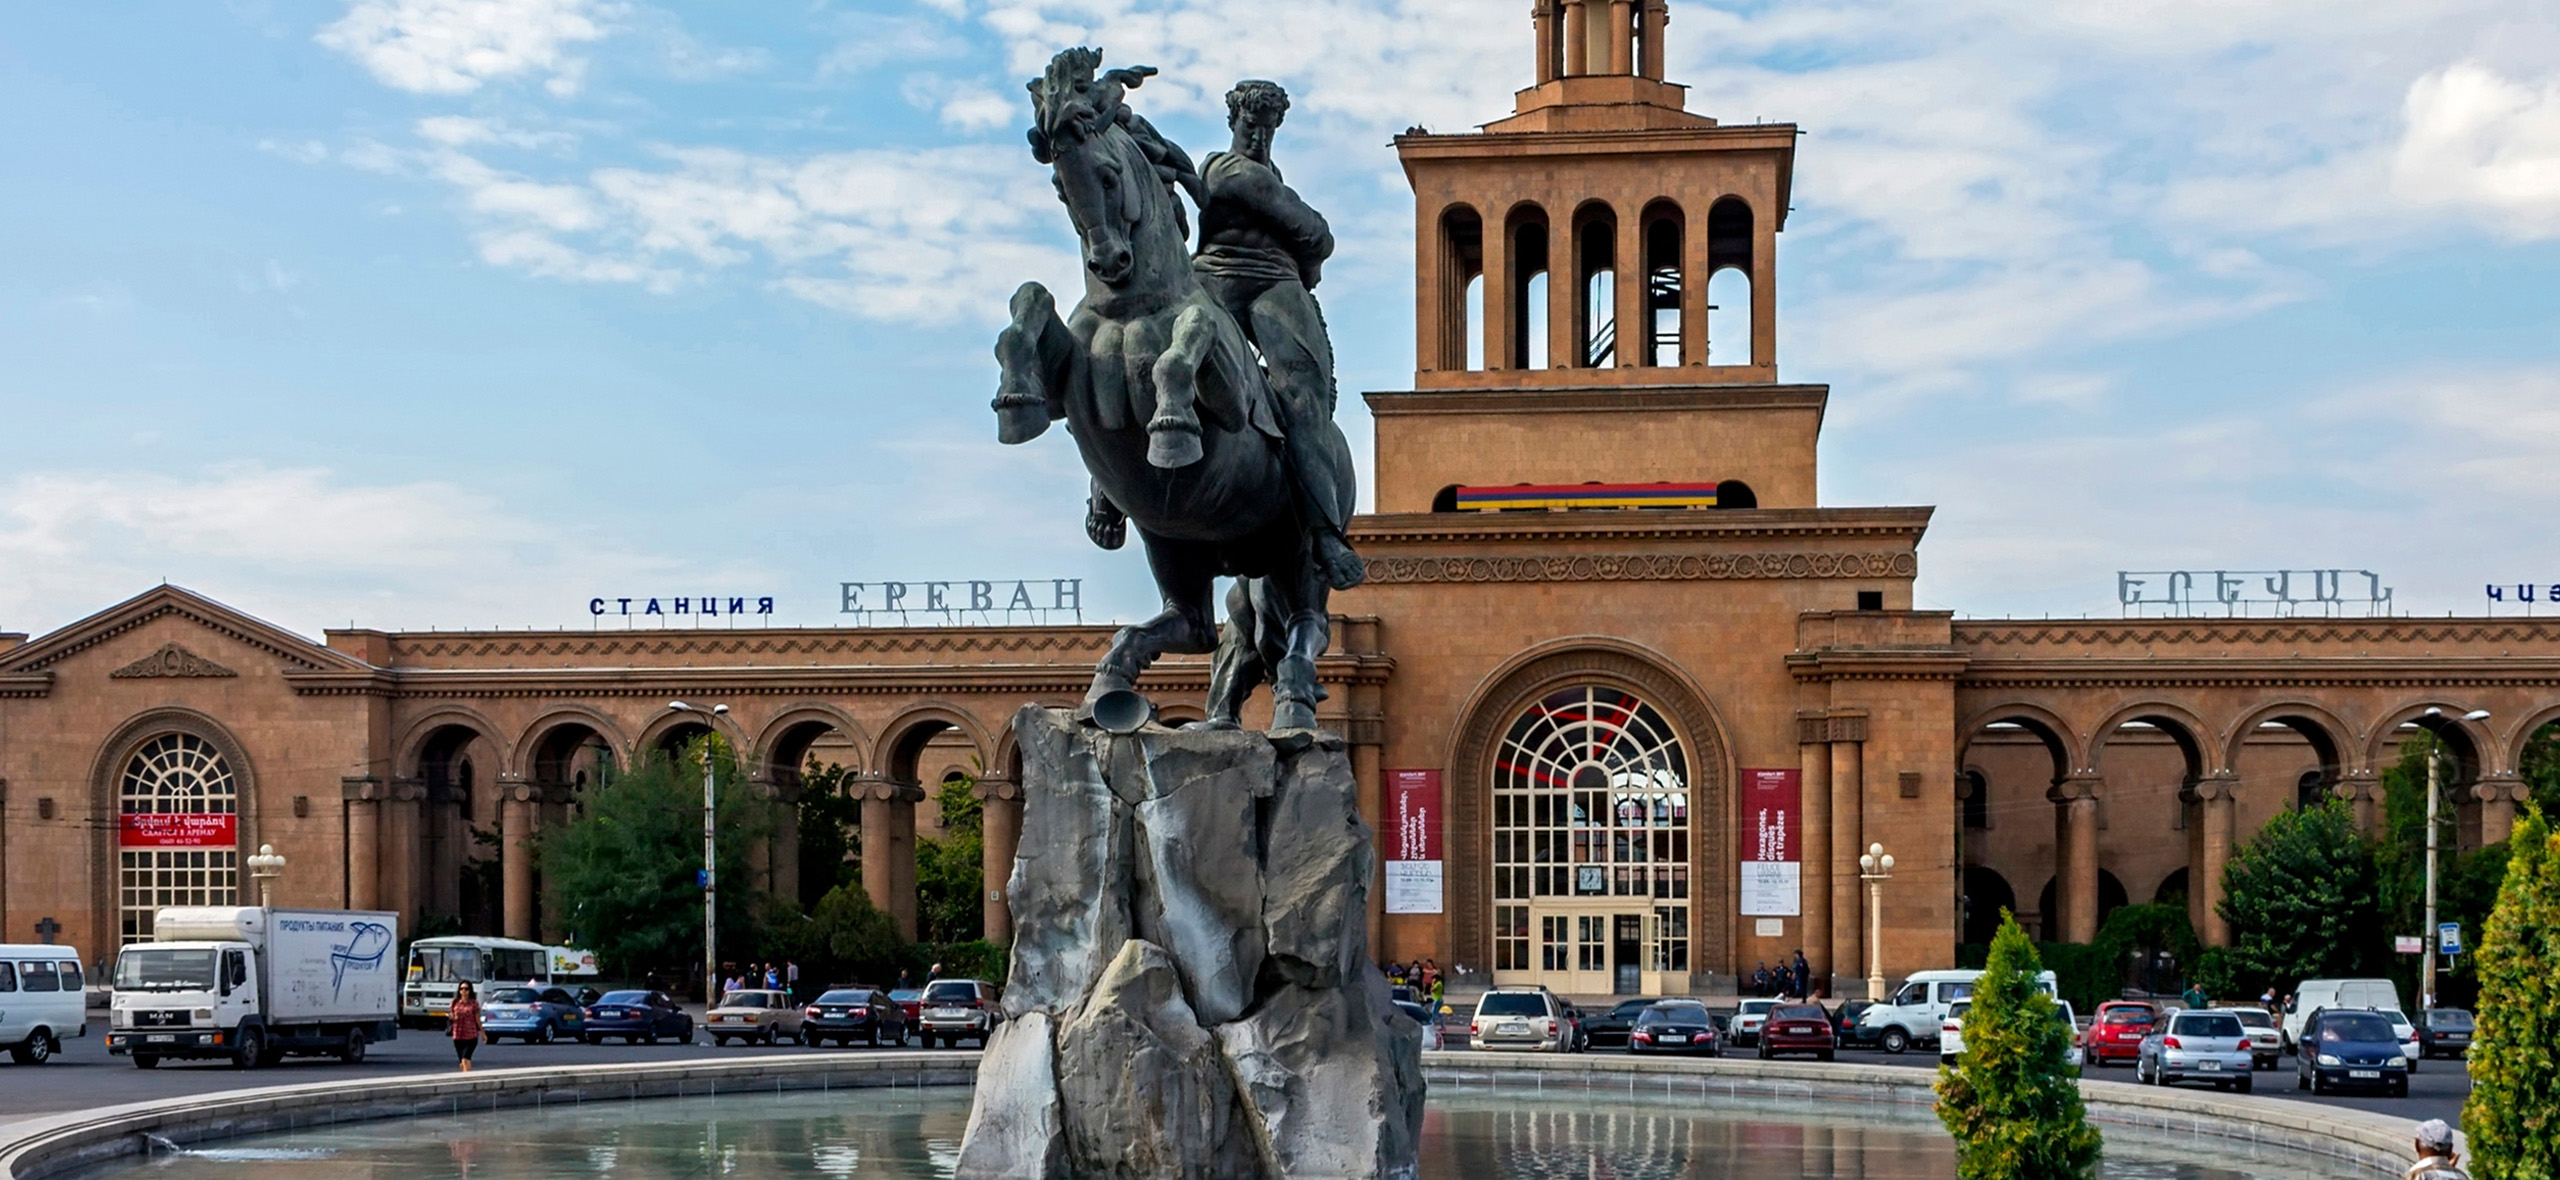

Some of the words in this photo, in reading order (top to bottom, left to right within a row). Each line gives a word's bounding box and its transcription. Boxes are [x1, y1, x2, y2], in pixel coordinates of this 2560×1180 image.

[590, 596, 774, 615] СТАНЦИЯ
[840, 578, 1083, 613] ЕРЕВАН
[2117, 569, 2393, 605] ԵՐԵՎԱՆ
[1757, 808, 1768, 861] Hexagones,
[1767, 825, 1777, 861] disques
[1776, 851, 1785, 861] et
[149, 1012, 174, 1020] MAN
